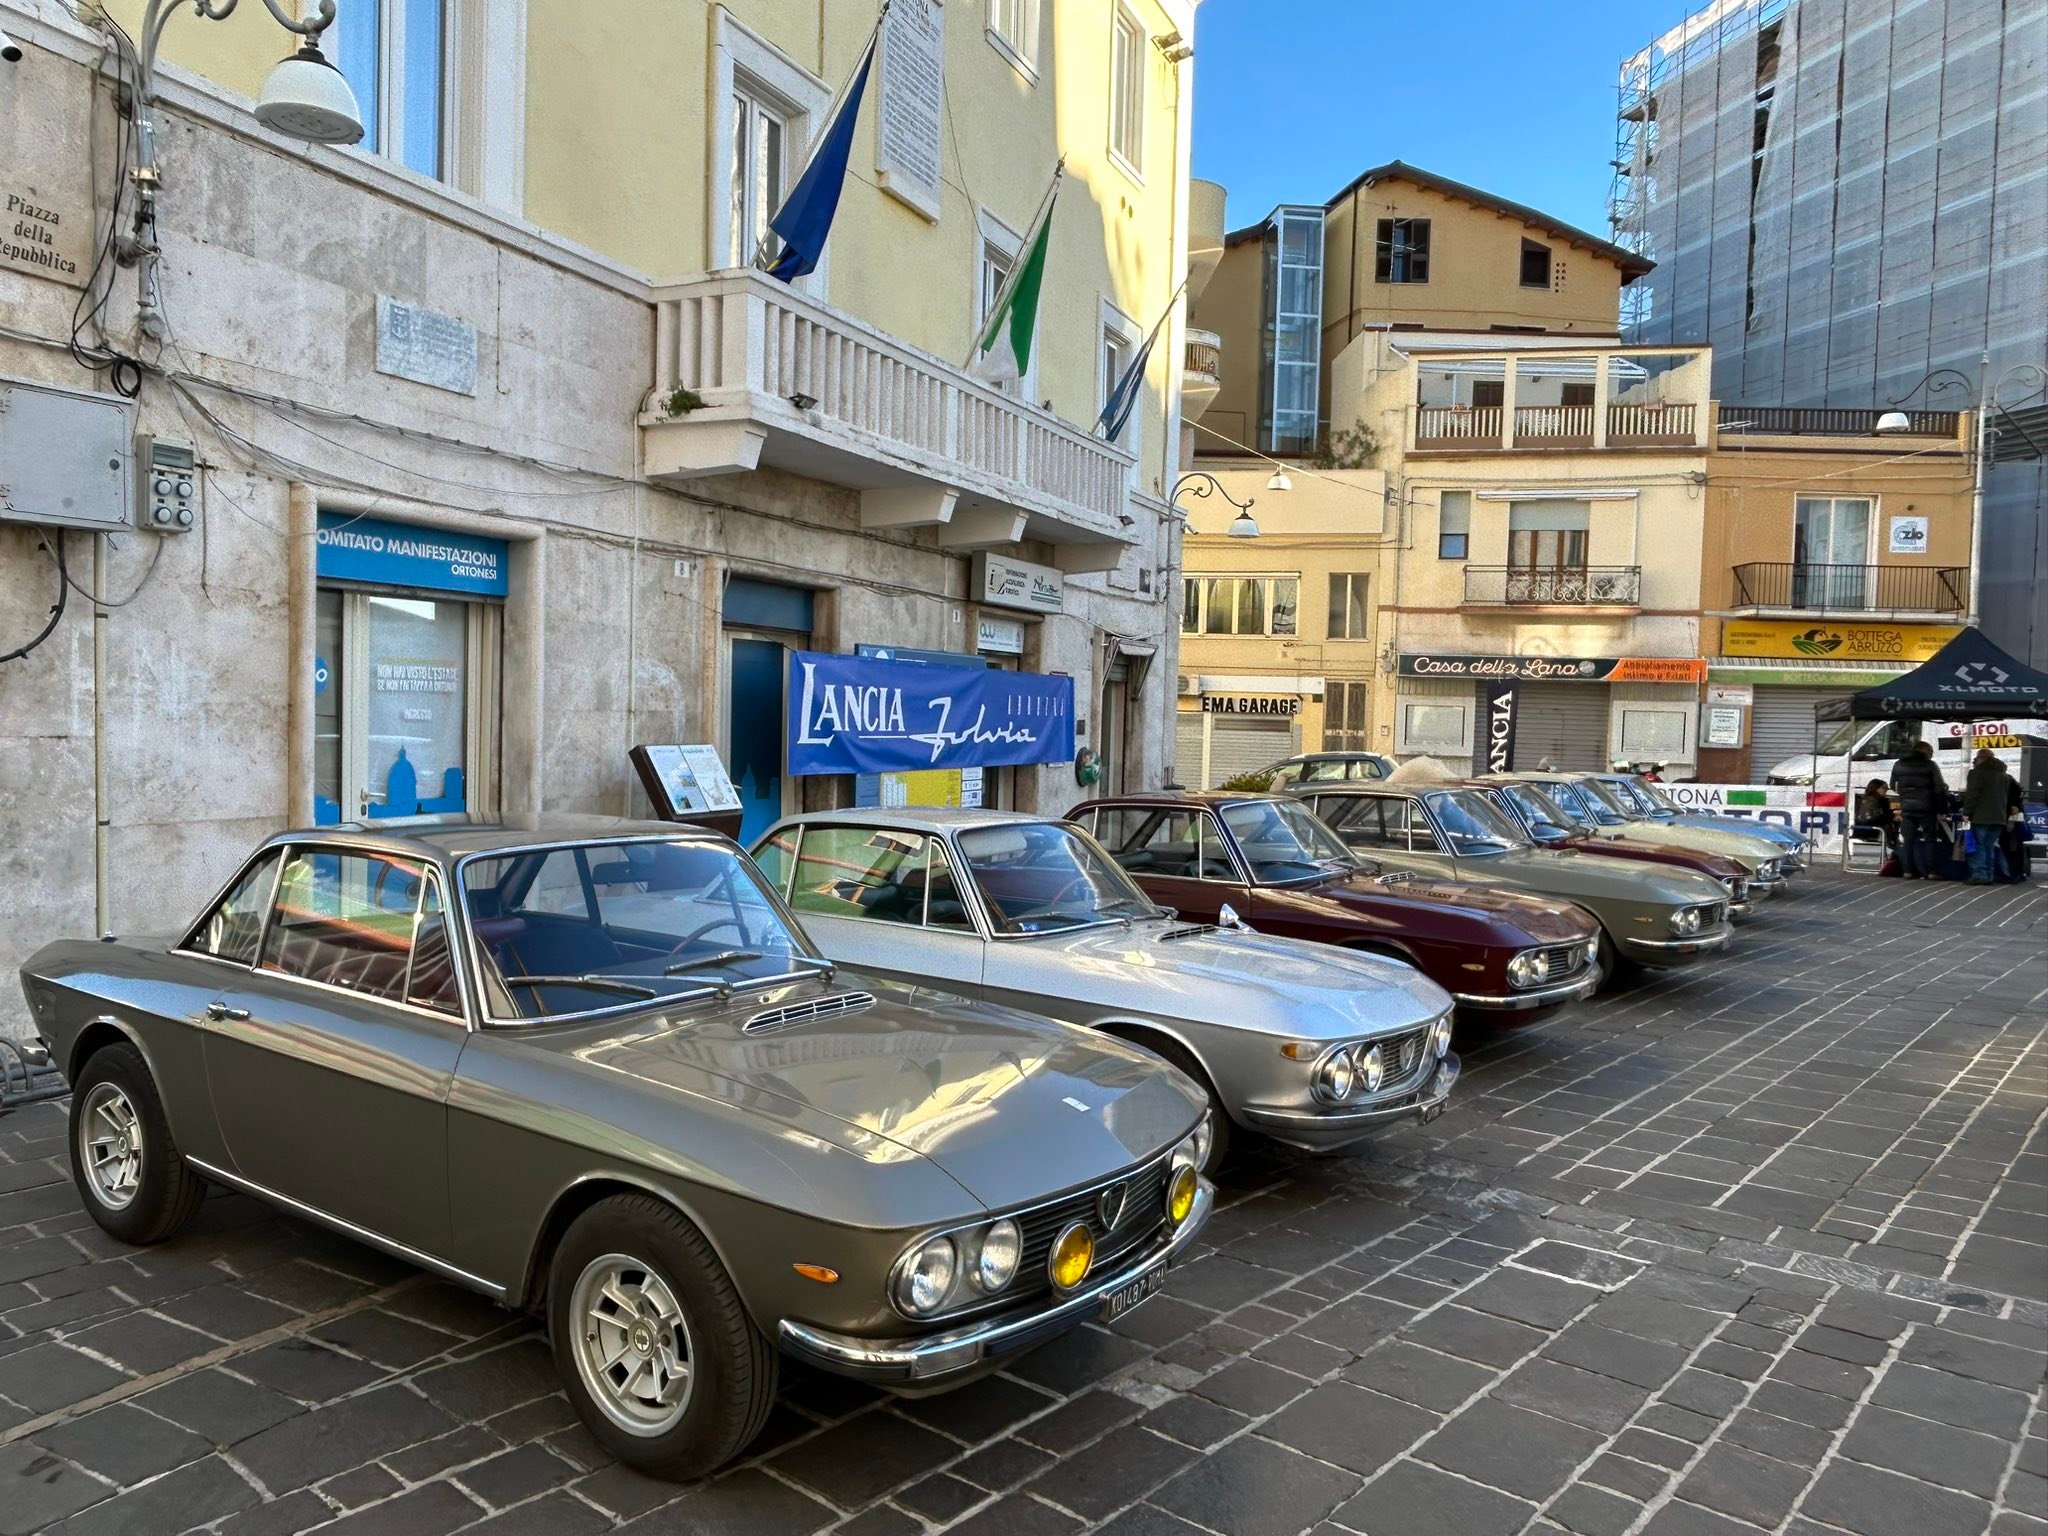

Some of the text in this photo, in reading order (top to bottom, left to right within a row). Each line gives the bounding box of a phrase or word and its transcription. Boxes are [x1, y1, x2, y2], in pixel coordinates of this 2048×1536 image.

[6, 193, 60, 225] Piazza
[14, 220, 53, 245] della
[0, 237, 76, 274] epubblica
[317, 529, 497, 567] OMITATO MANIFESTAZIONI
[451, 564, 497, 580] ORTONESI
[1847, 629, 1903, 642] BOTTEGA
[1847, 641, 1903, 654] ABRUZZO
[1414, 657, 1579, 678] Casa della Lana
[1783, 672, 1829, 683] BOTTEGA
[1938, 684, 2039, 693] XLMOTO
[797, 662, 1037, 763] LANCIA Fulvia
[1202, 696, 1298, 715] EMA GARAGE
[1904, 701, 1966, 710] XLMOTO
[1489, 690, 1513, 774] ANCIA
[1659, 788, 1723, 805] TONA
